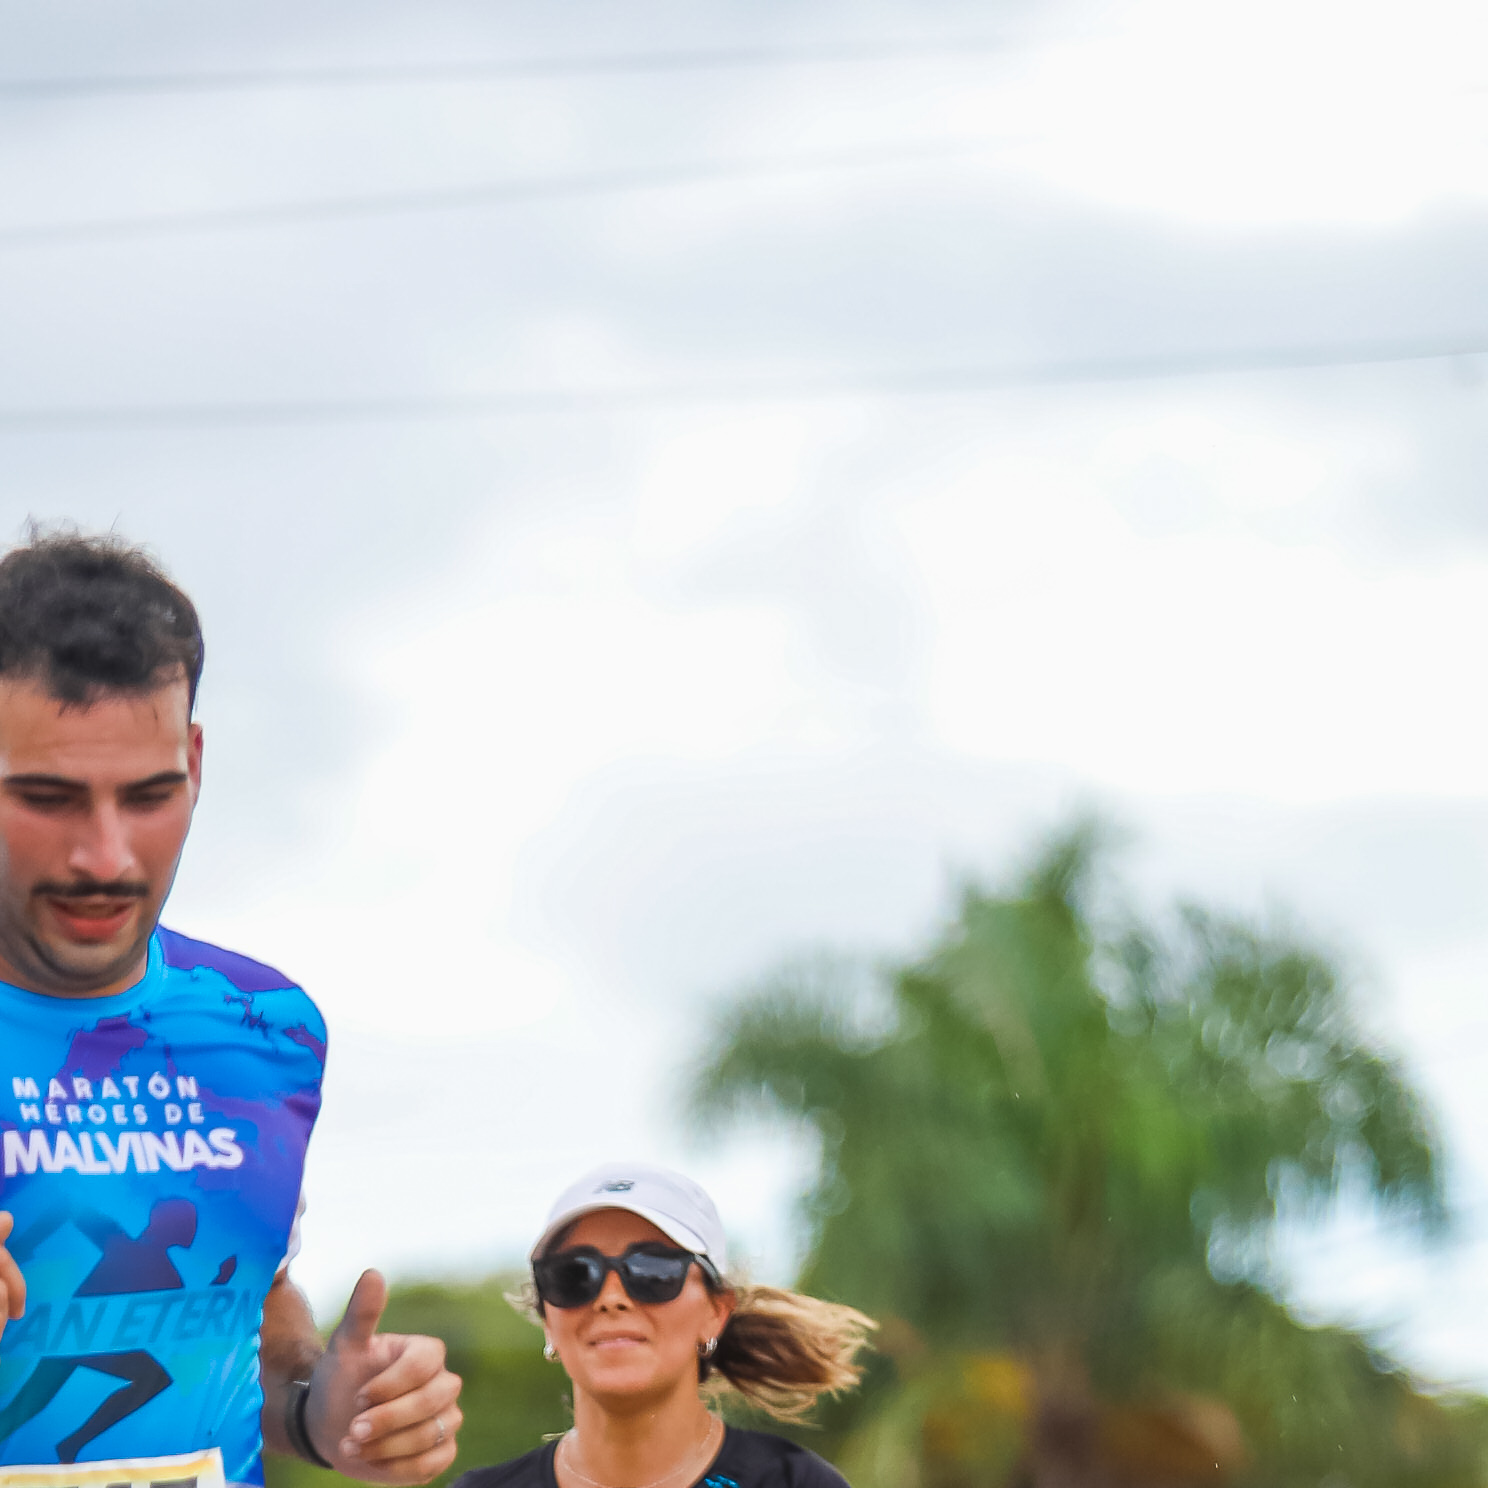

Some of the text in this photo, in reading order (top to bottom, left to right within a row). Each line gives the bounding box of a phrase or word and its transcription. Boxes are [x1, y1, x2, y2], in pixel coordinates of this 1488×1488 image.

[12, 1071, 198, 1099] MARATÓN
[165, 1103, 205, 1125] DE
[3, 1128, 244, 1177] MALVINAS
